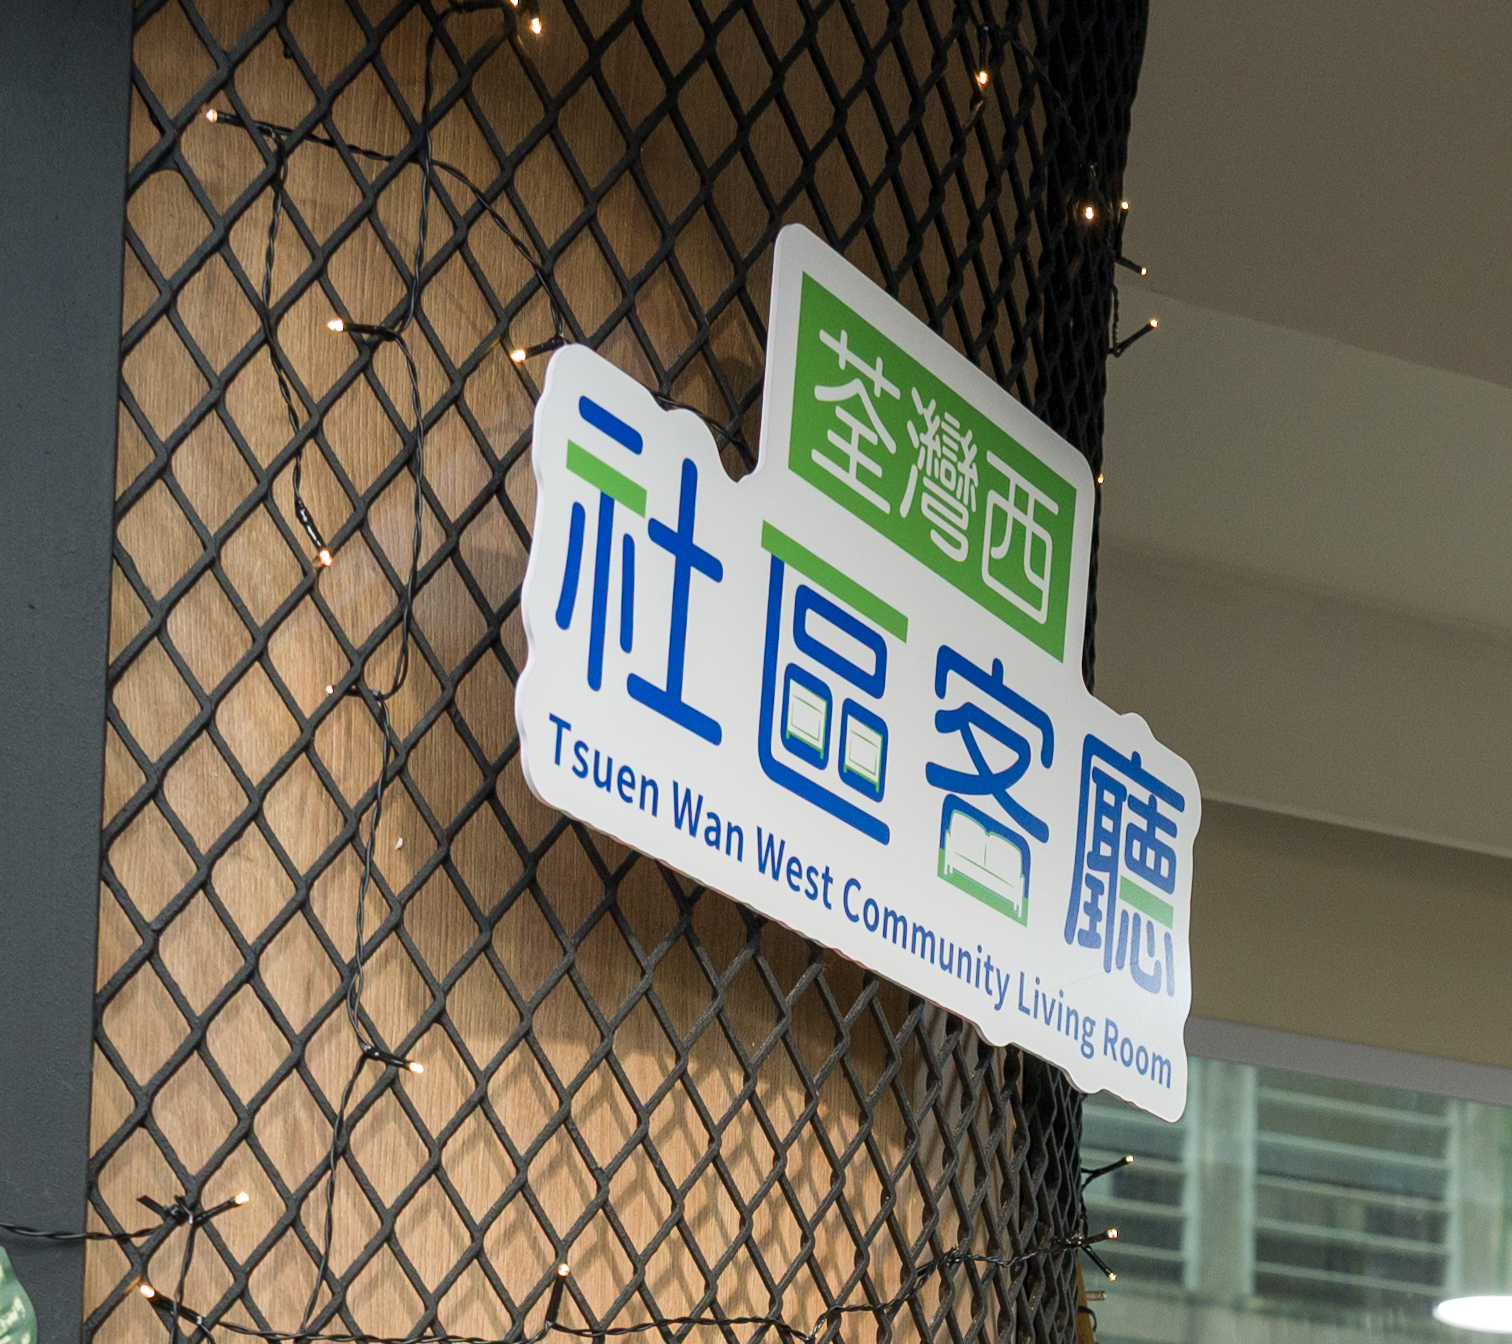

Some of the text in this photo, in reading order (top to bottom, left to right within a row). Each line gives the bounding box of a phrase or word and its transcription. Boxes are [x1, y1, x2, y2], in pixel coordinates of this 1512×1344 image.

[813, 328, 1061, 626] 荃灣西
[555, 394, 1186, 1000] 社區客廳
[549, 712, 1172, 1089] Tsuen Wan West Community Living Room
